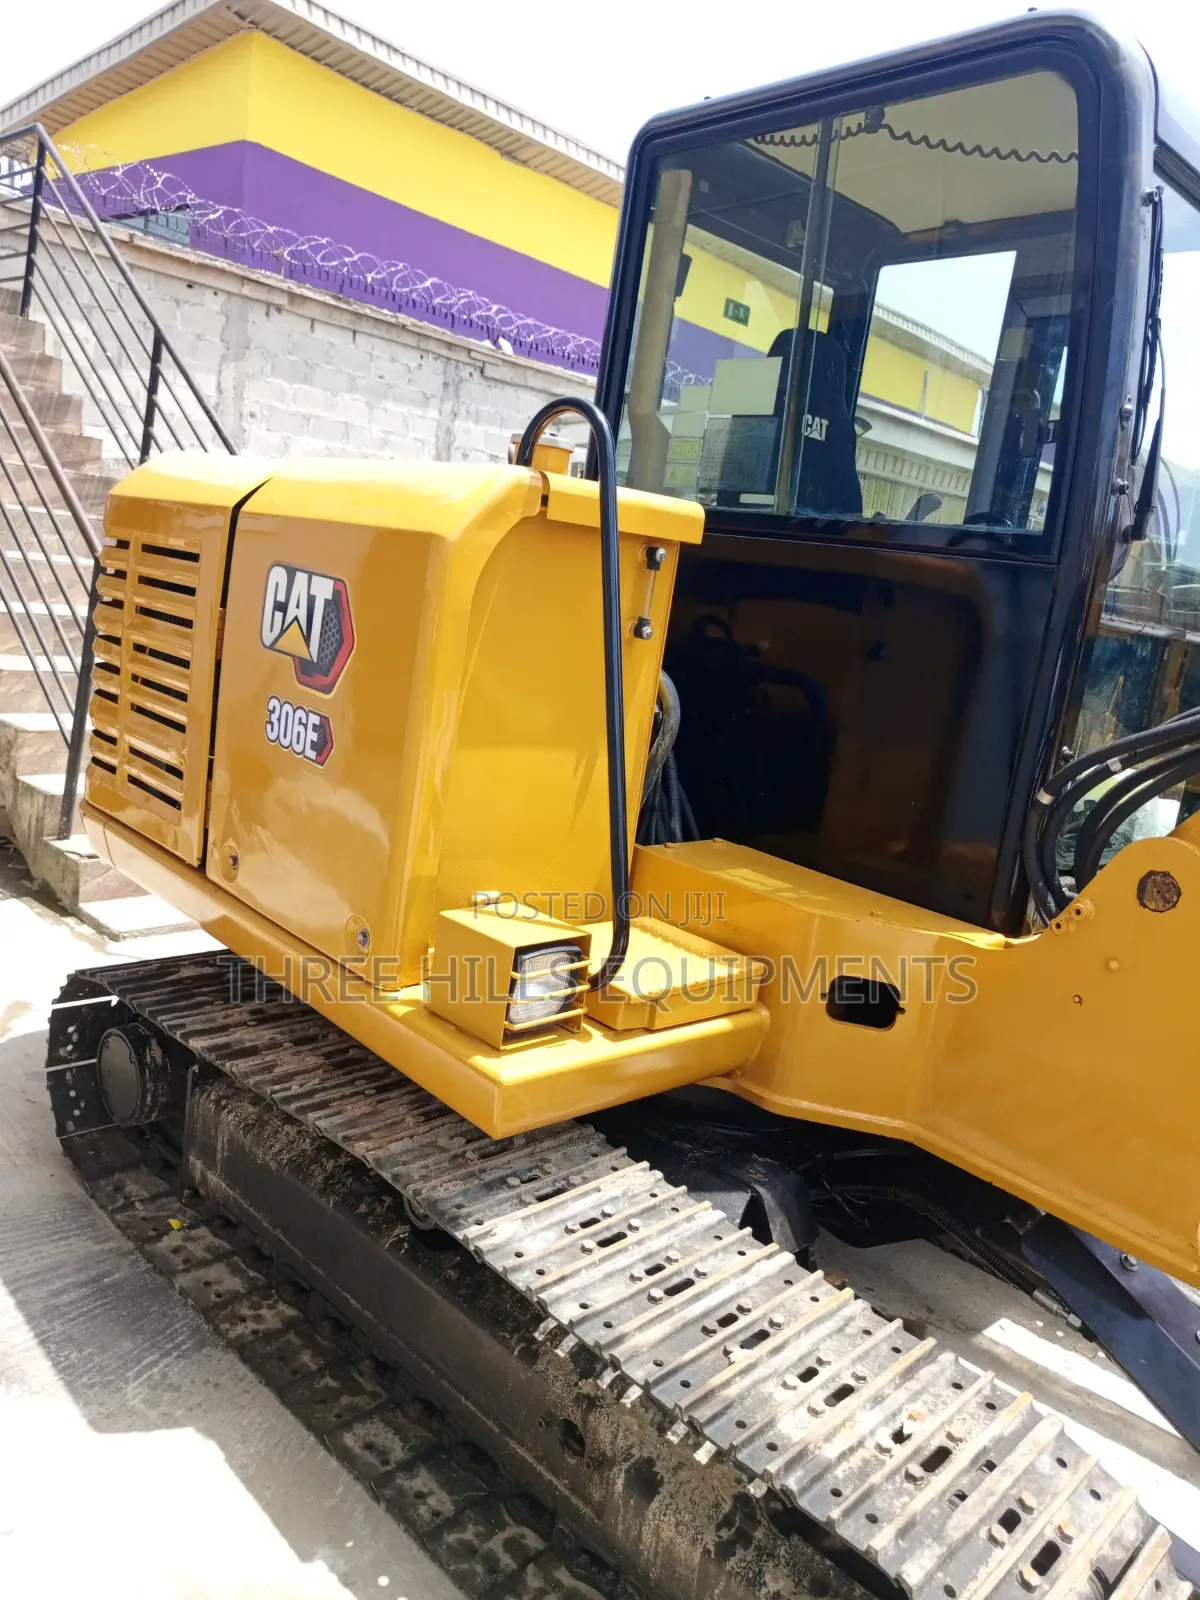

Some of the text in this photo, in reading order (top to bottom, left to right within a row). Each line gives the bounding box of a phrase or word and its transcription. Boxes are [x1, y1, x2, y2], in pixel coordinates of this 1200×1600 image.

[803, 413, 829, 442] CAT
[261, 565, 335, 663] CAT
[265, 697, 321, 760] 306E
